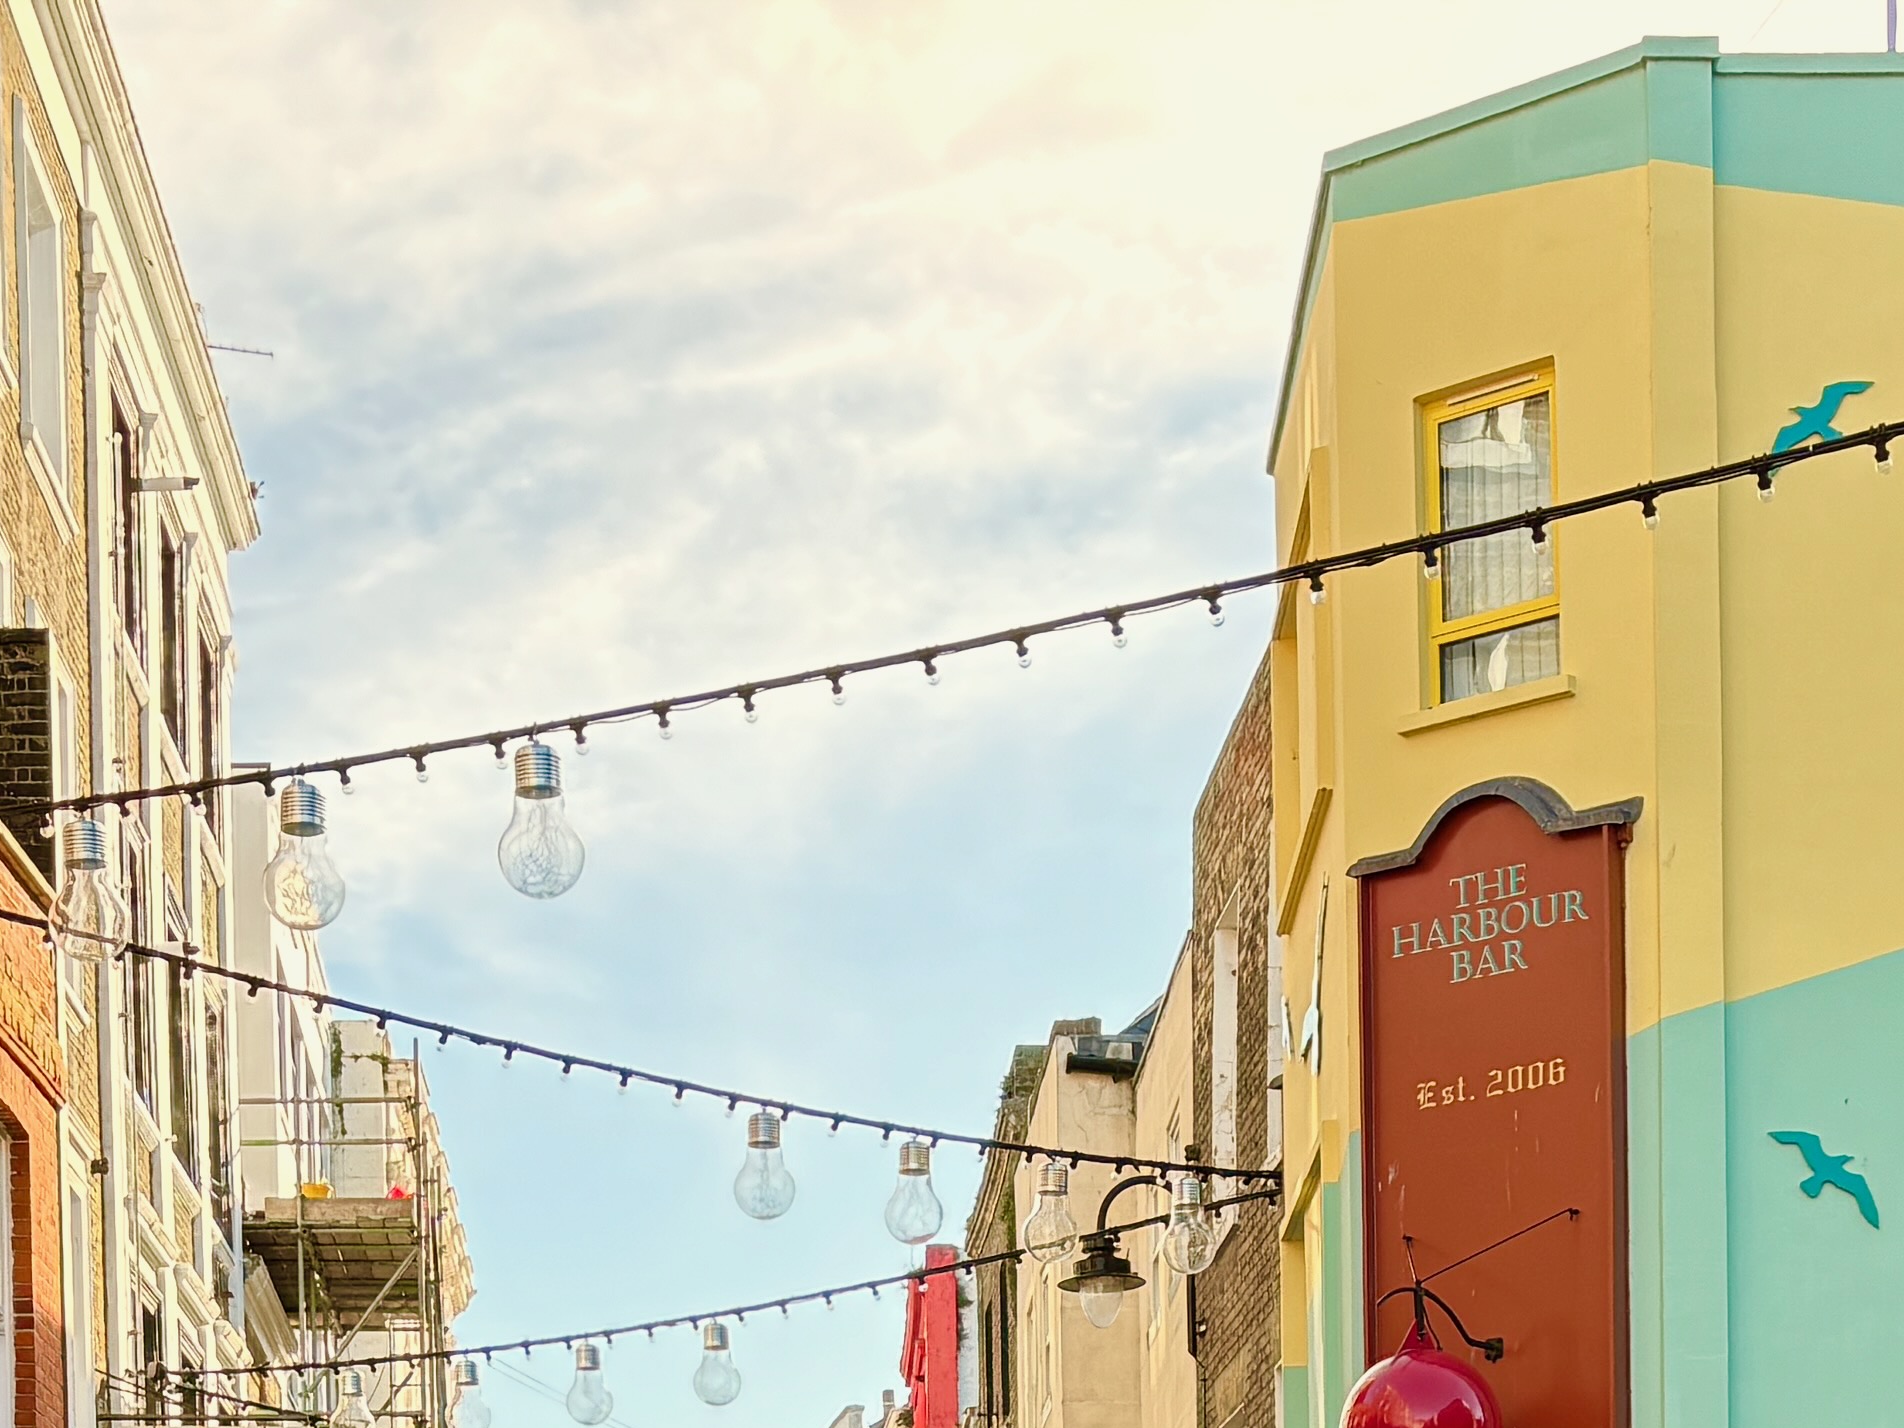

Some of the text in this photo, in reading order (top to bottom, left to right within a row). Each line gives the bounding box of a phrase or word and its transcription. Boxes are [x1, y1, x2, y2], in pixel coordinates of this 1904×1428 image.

[1449, 863, 1527, 909] THE
[1391, 889, 1589, 958] HARBOUR
[1449, 939, 1528, 984] BAR
[1416, 1057, 1566, 1110] Est. 2006
